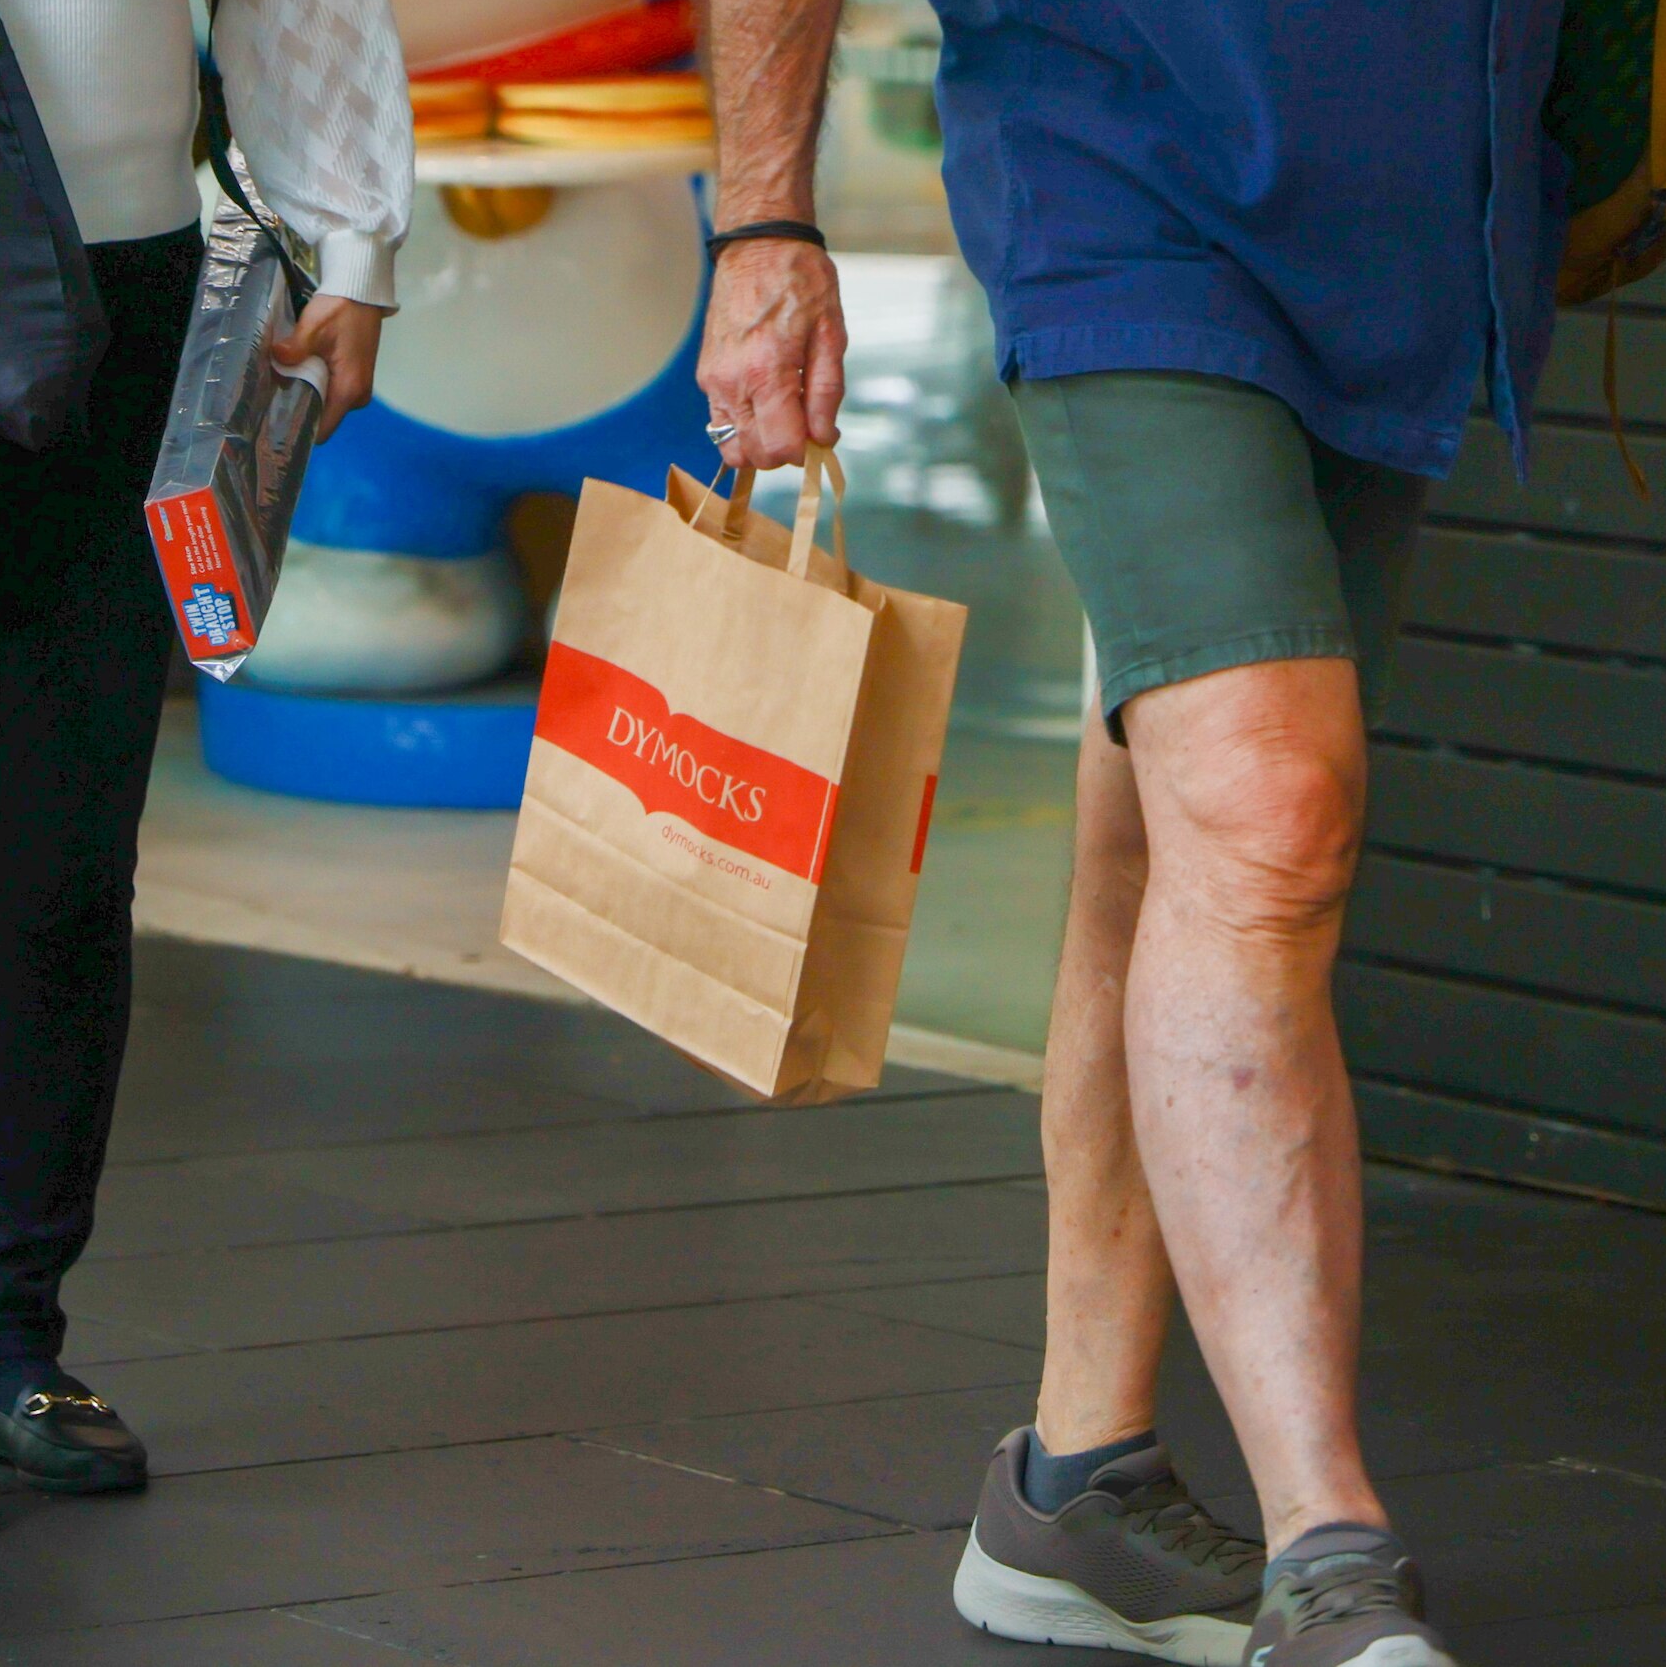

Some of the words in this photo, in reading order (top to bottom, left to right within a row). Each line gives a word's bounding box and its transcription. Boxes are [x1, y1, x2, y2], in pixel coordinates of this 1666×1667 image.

[187, 526, 197, 545] length
[185, 603, 207, 635] TWIN
[194, 587, 224, 645] DRAUGHT
[214, 597, 236, 630] STOP
[606, 704, 767, 823] DYMOCKS
[661, 823, 772, 891] dymocks.com.au
